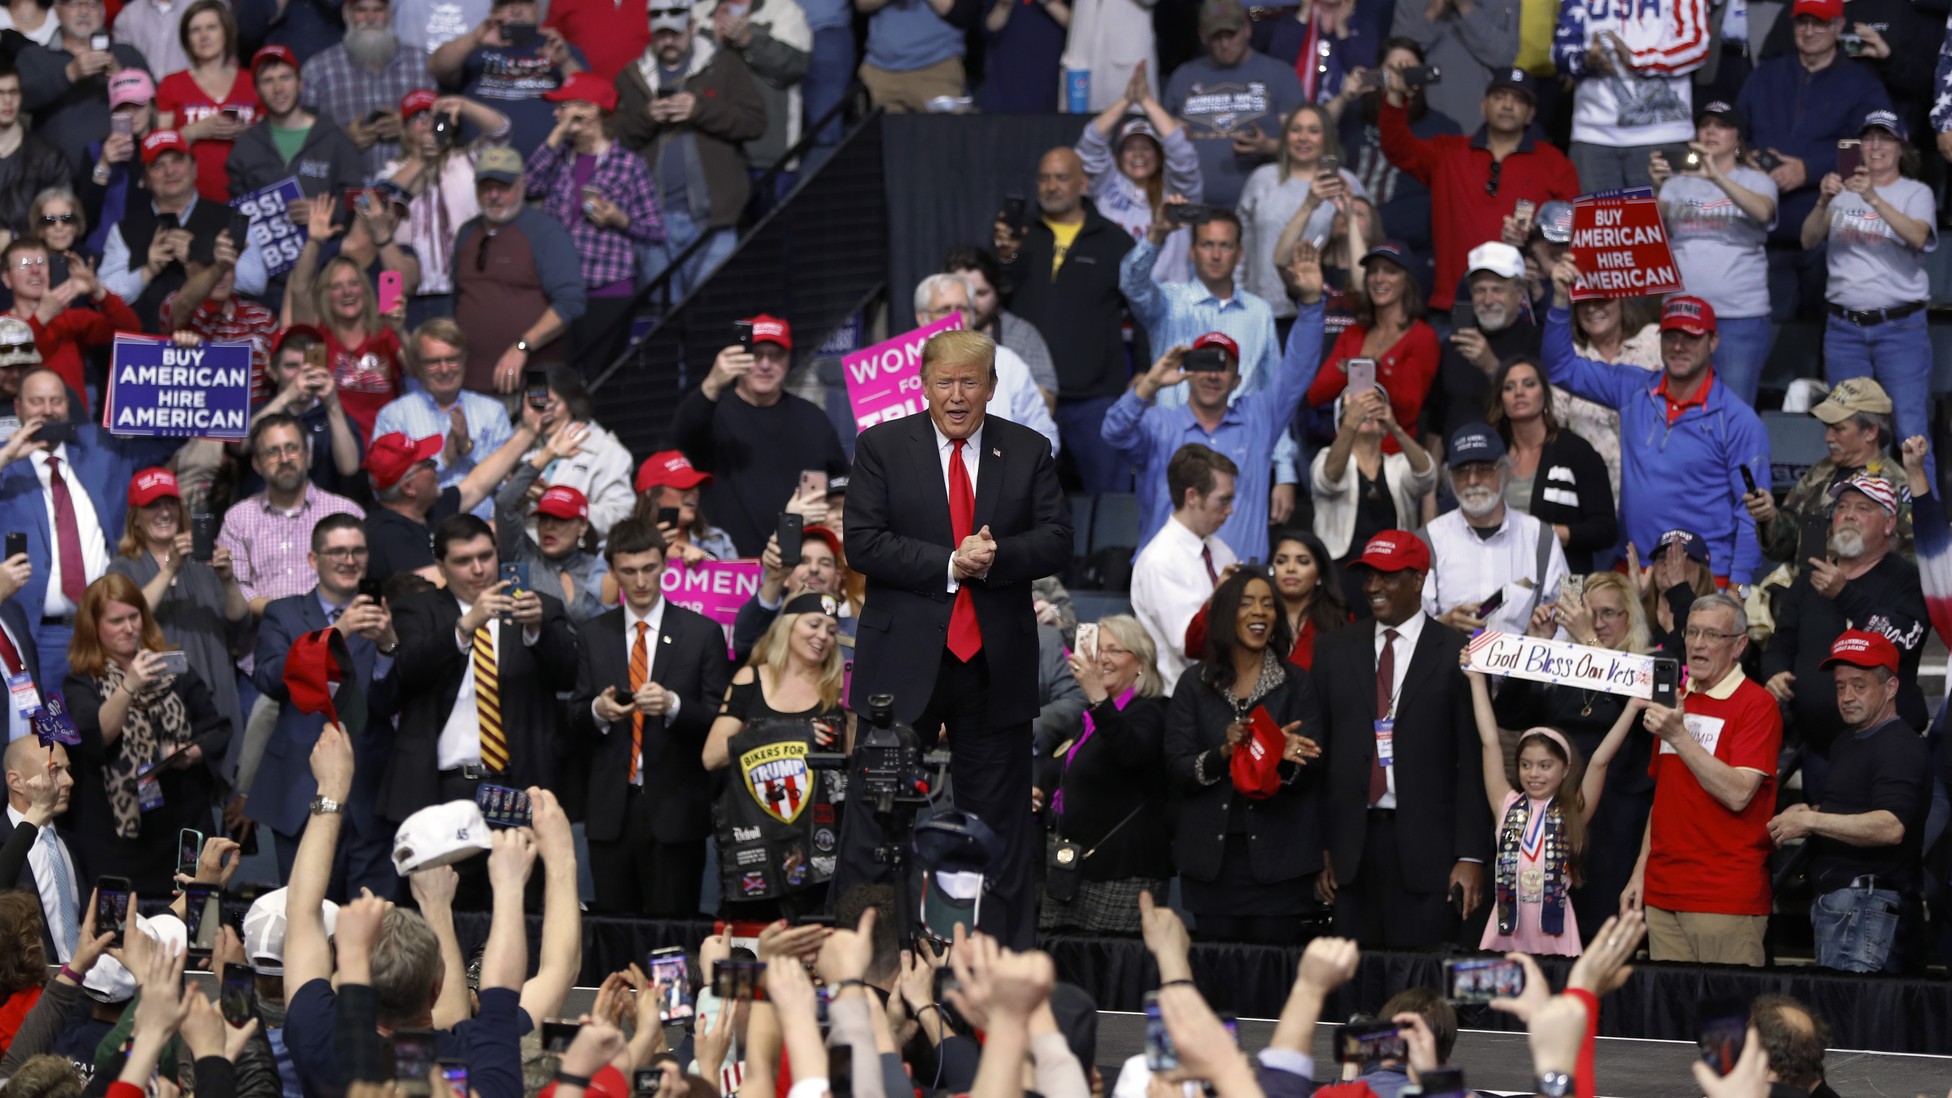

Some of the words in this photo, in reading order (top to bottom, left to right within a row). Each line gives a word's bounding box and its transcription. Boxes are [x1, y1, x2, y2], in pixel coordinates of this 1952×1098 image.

[1595, 209, 1623, 226] BUY
[1571, 225, 1663, 248] AMERICAN
[1596, 251, 1636, 269] HIRE
[1574, 265, 1676, 291] AMERICAN
[162, 348, 205, 366] BUY
[849, 321, 962, 385] WOM
[119, 364, 246, 388] AMERICAN
[898, 375, 922, 395] FO
[158, 390, 207, 408] HIRE
[117, 406, 244, 429] AMERICAN
[660, 567, 758, 597] OMEN
[1486, 641, 1523, 668] God
[1525, 645, 1573, 677] Bless
[1575, 653, 1603, 679] Our
[1607, 658, 1635, 686] Vets
[743, 746, 780, 767] BIKERS
[784, 745, 804, 755] FOR
[749, 759, 805, 784] TRUMP
